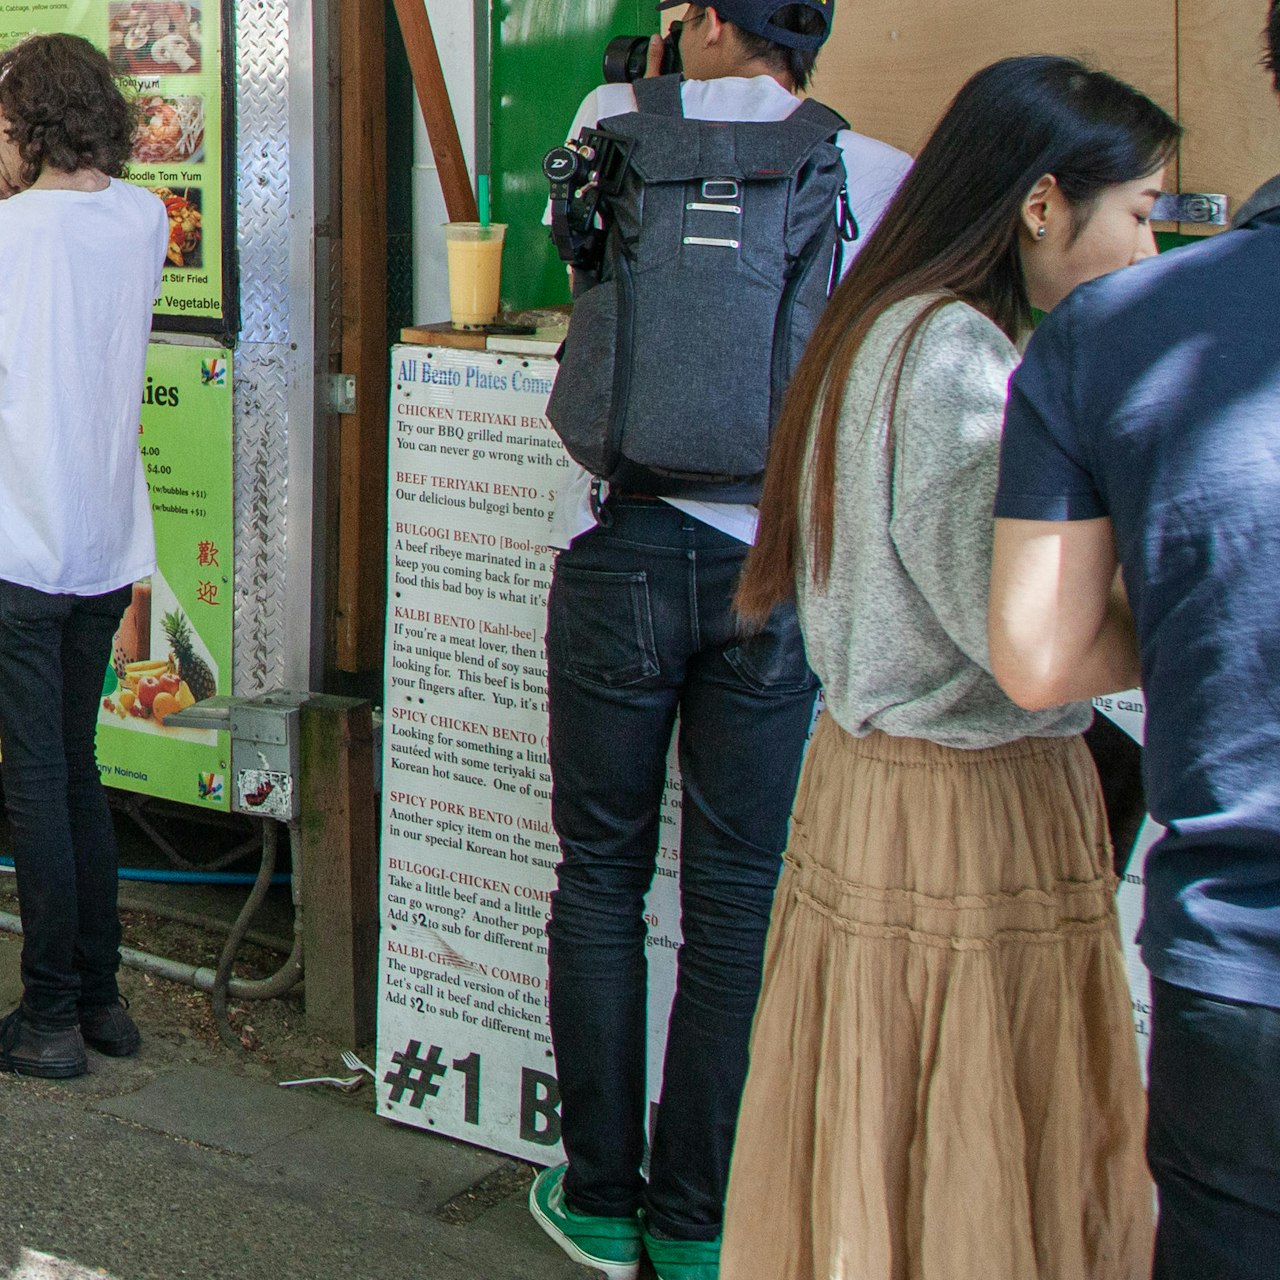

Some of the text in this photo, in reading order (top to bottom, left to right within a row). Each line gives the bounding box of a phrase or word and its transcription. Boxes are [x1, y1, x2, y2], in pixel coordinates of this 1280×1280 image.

[159, 172, 201, 180] Tom Yum
[170, 274, 207, 283] Stir Fried
[165, 296, 220, 310] Vegetable
[398, 359, 553, 394] All Bento Plates Come
[398, 403, 516, 427] CHICKEN TERIYAKI
[147, 463, 171, 475] $4.00
[396, 471, 537, 499] BEEF TERIYAKI BENTO
[395, 522, 496, 546] BULGOGI BENTO
[394, 606, 536, 642] KALBI BENTO [Kahl-bee]
[392, 707, 536, 745] SPICY CHICKEN BENTO
[390, 791, 513, 825] SPICY PORK BENTO
[389, 857, 510, 895] BULGOGI-CHICKEN
[383, 1038, 481, 1126] #1
